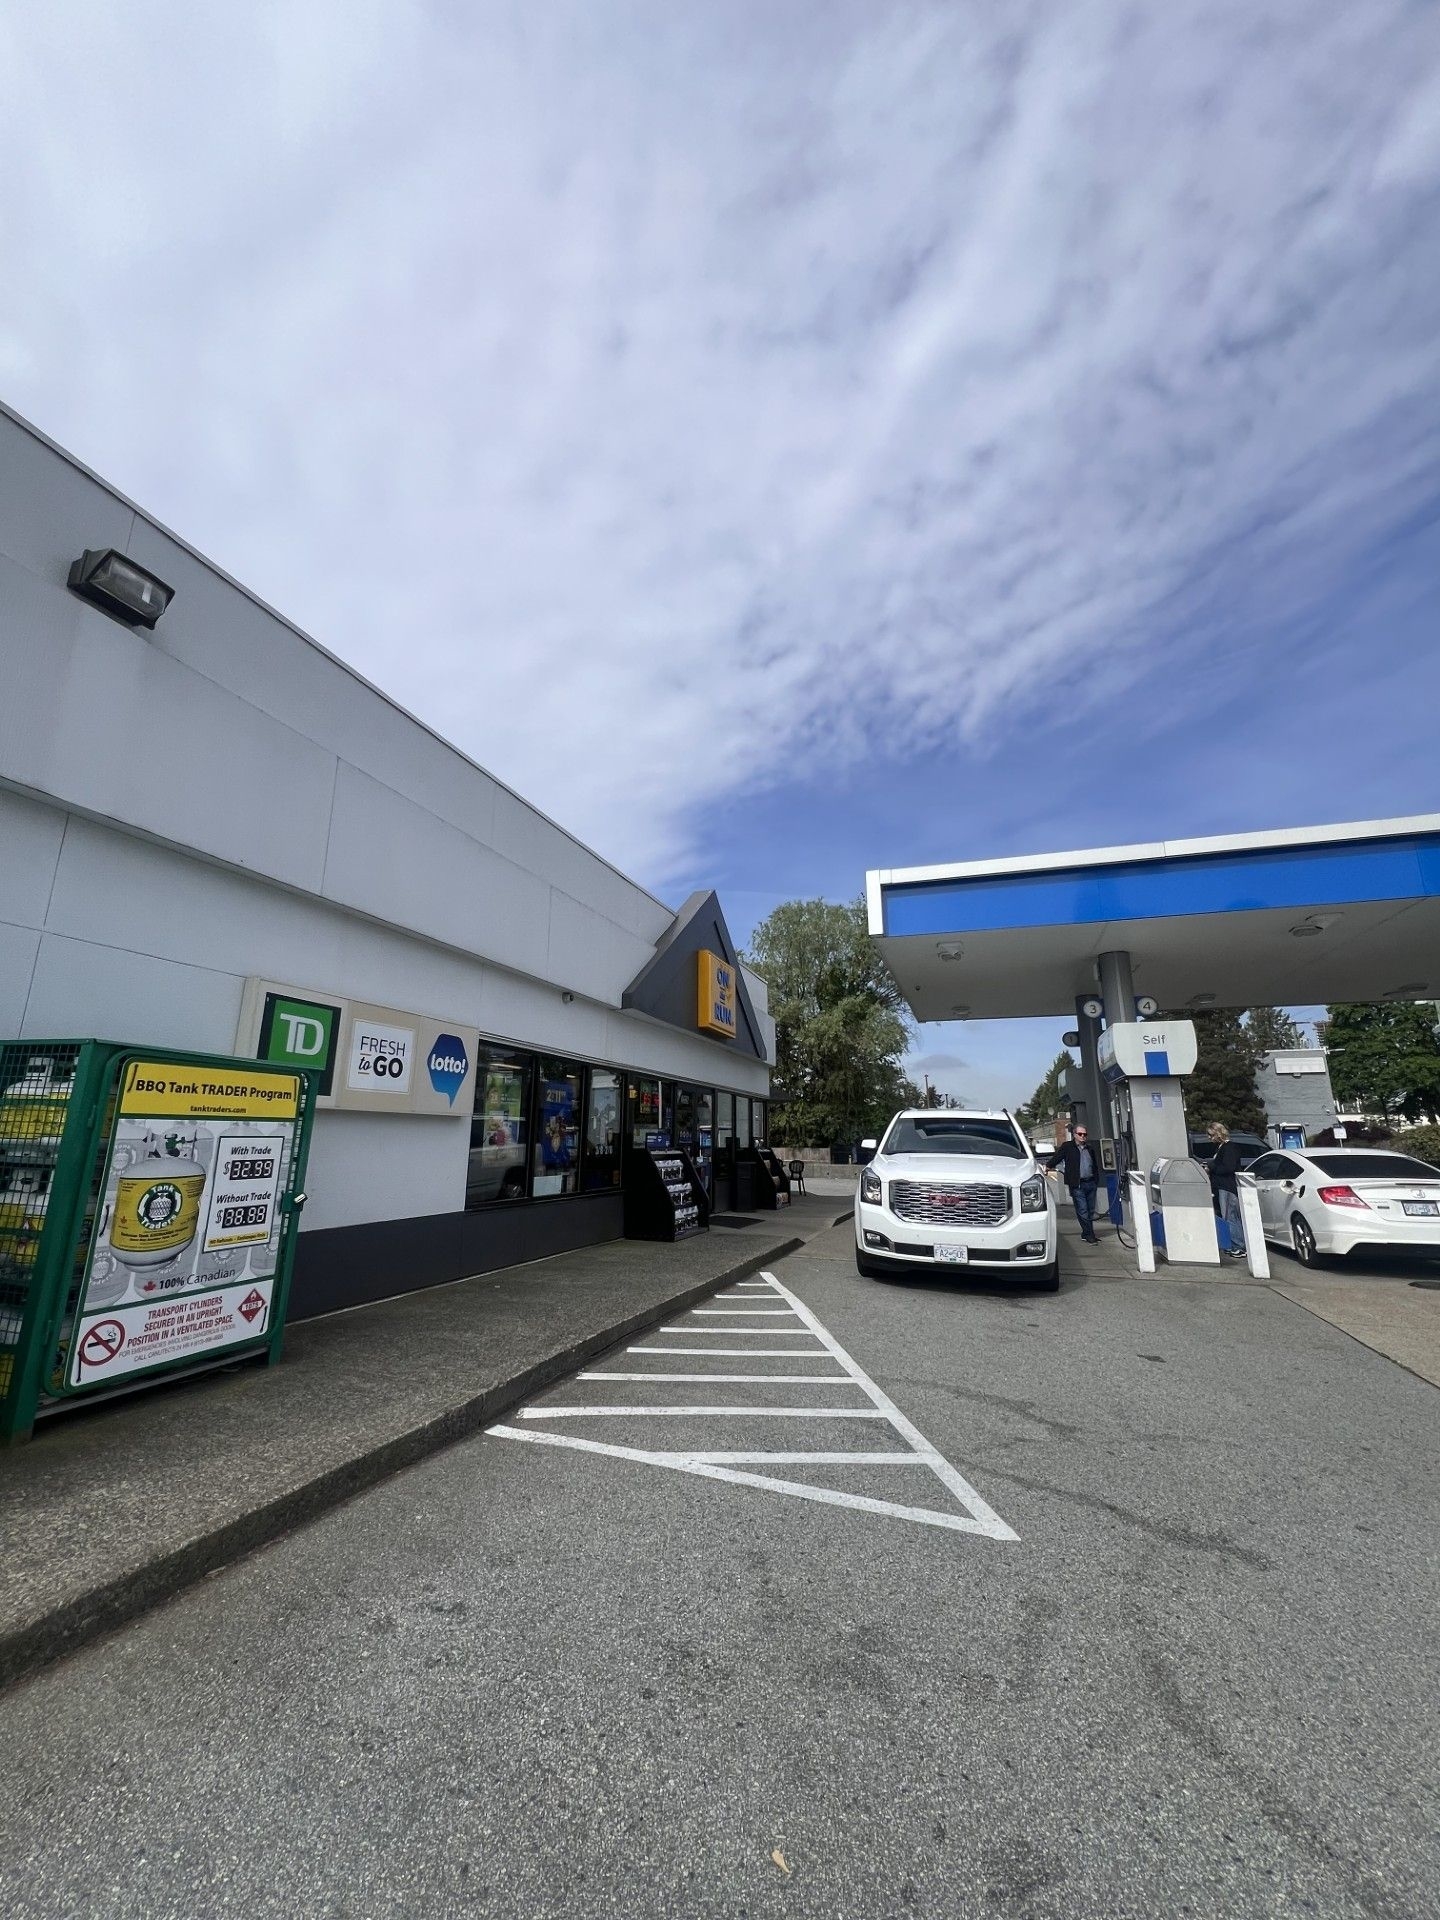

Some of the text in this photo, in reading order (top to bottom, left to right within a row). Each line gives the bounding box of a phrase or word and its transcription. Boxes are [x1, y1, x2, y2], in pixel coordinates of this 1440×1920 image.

[715, 1003, 731, 1026] RUN
[1089, 1004, 1097, 1014] 3
[1143, 1001, 1151, 1011] 4
[280, 1013, 325, 1056] TD
[1143, 1034, 1166, 1045] Self
[360, 1035, 406, 1057] FRESH
[358, 1056, 404, 1078] to GO
[430, 1053, 467, 1074] lotto!
[136, 1079, 292, 1102] BBQ Tank TRADER Program
[190, 1105, 247, 1114] tanktraders.com
[231, 1146, 272, 1155] With Trade
[223, 1161, 273, 1178] $32.99
[151, 1185, 175, 1193] Tank
[216, 1191, 272, 1205] Without Trade
[141, 1215, 177, 1229] Traders
[159, 1269, 236, 1290] 100% Canadian
[148, 1296, 223, 1320] TRANSPORT CYLINDERS
[144, 1306, 223, 1332] SECURED IN AN UPRIGHT
[127, 1314, 233, 1348] POSITION IN A VENTILATED SPACE
